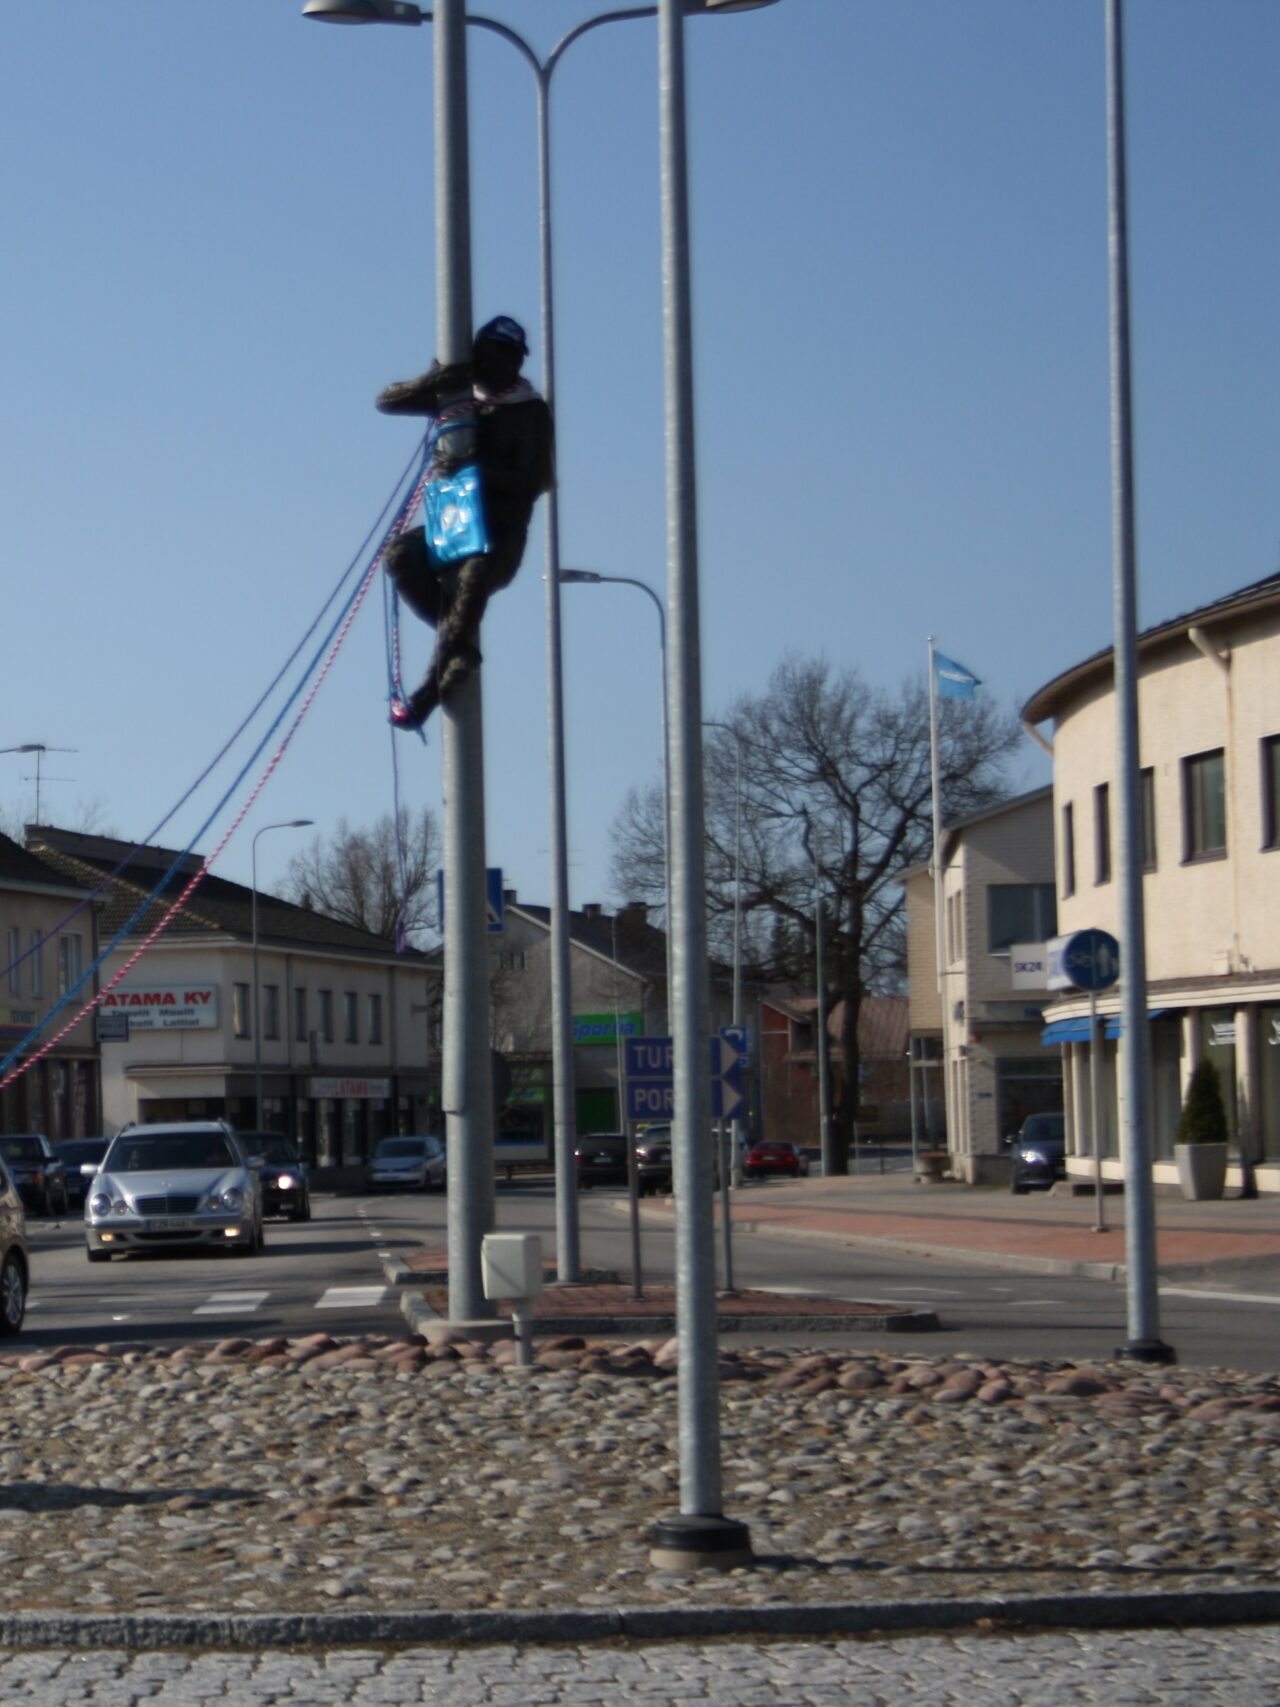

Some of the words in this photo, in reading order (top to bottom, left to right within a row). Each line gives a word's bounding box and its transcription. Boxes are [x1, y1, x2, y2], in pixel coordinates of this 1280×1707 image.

[103, 992, 176, 1007] ATAMA
[184, 992, 212, 1005] KY
[634, 1045, 673, 1069] TUR
[634, 1088, 673, 1112] POR
